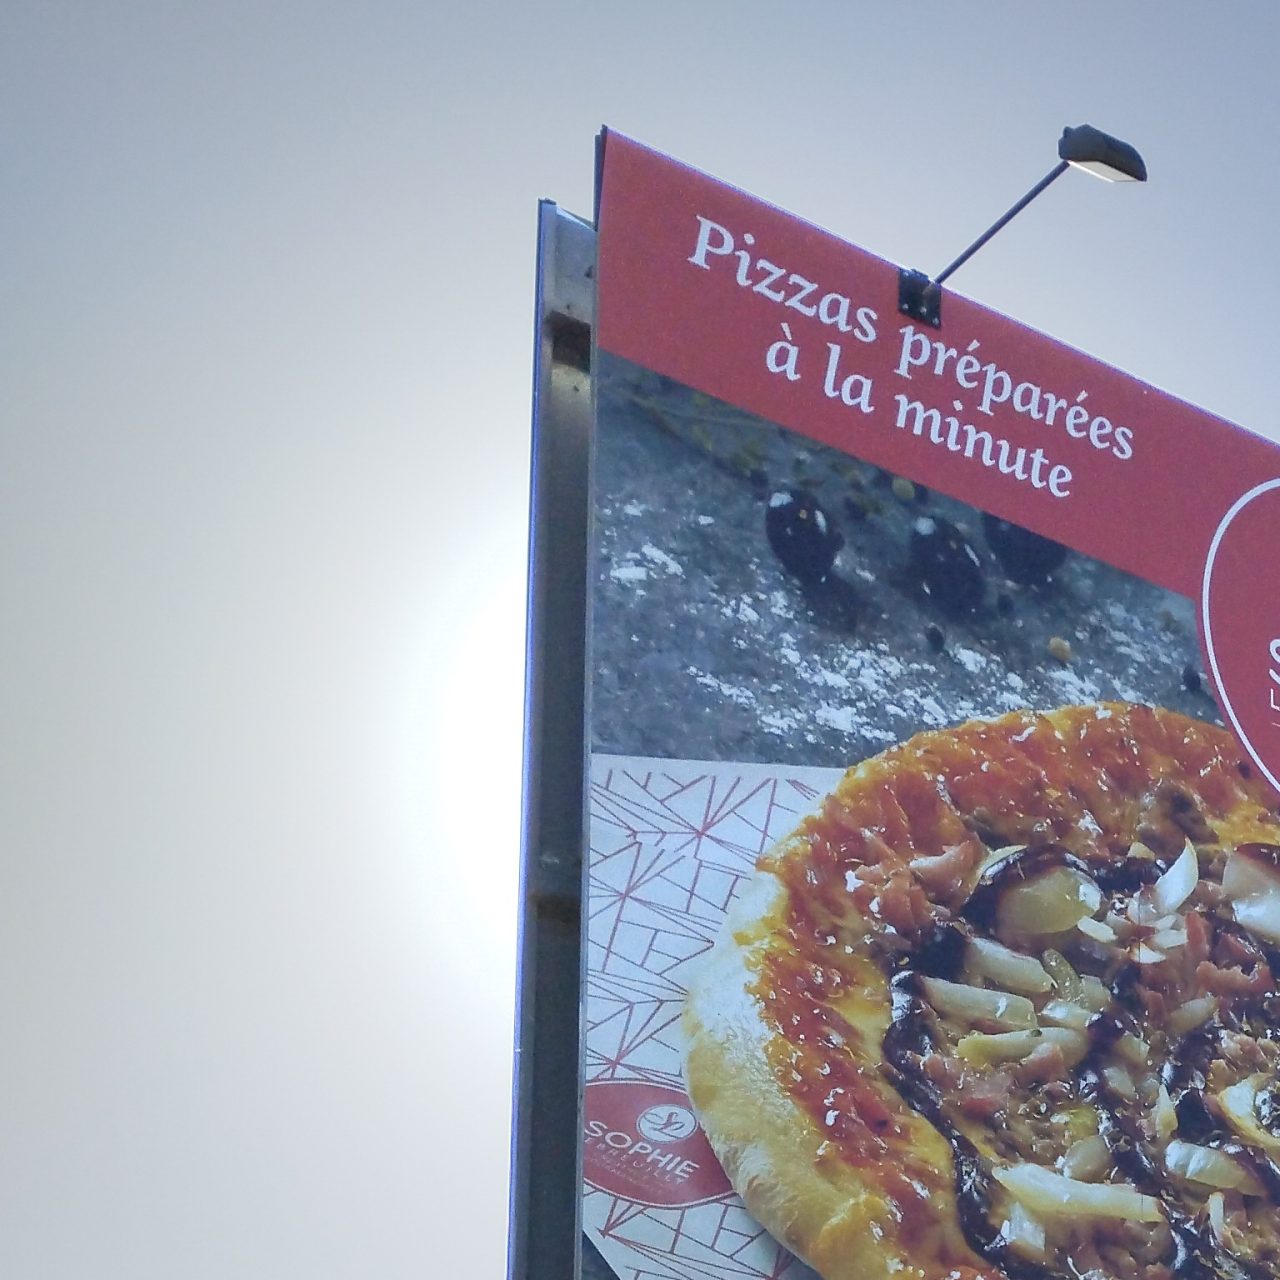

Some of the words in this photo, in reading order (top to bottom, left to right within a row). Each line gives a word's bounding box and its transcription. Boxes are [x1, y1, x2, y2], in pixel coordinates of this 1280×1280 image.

[687, 215, 878, 344] Pizzas
[893, 324, 1134, 461] préparées
[766, 322, 801, 383] à
[824, 342, 875, 414] la
[893, 394, 1073, 499] minute
[584, 1120, 700, 1178] SOPHIE
